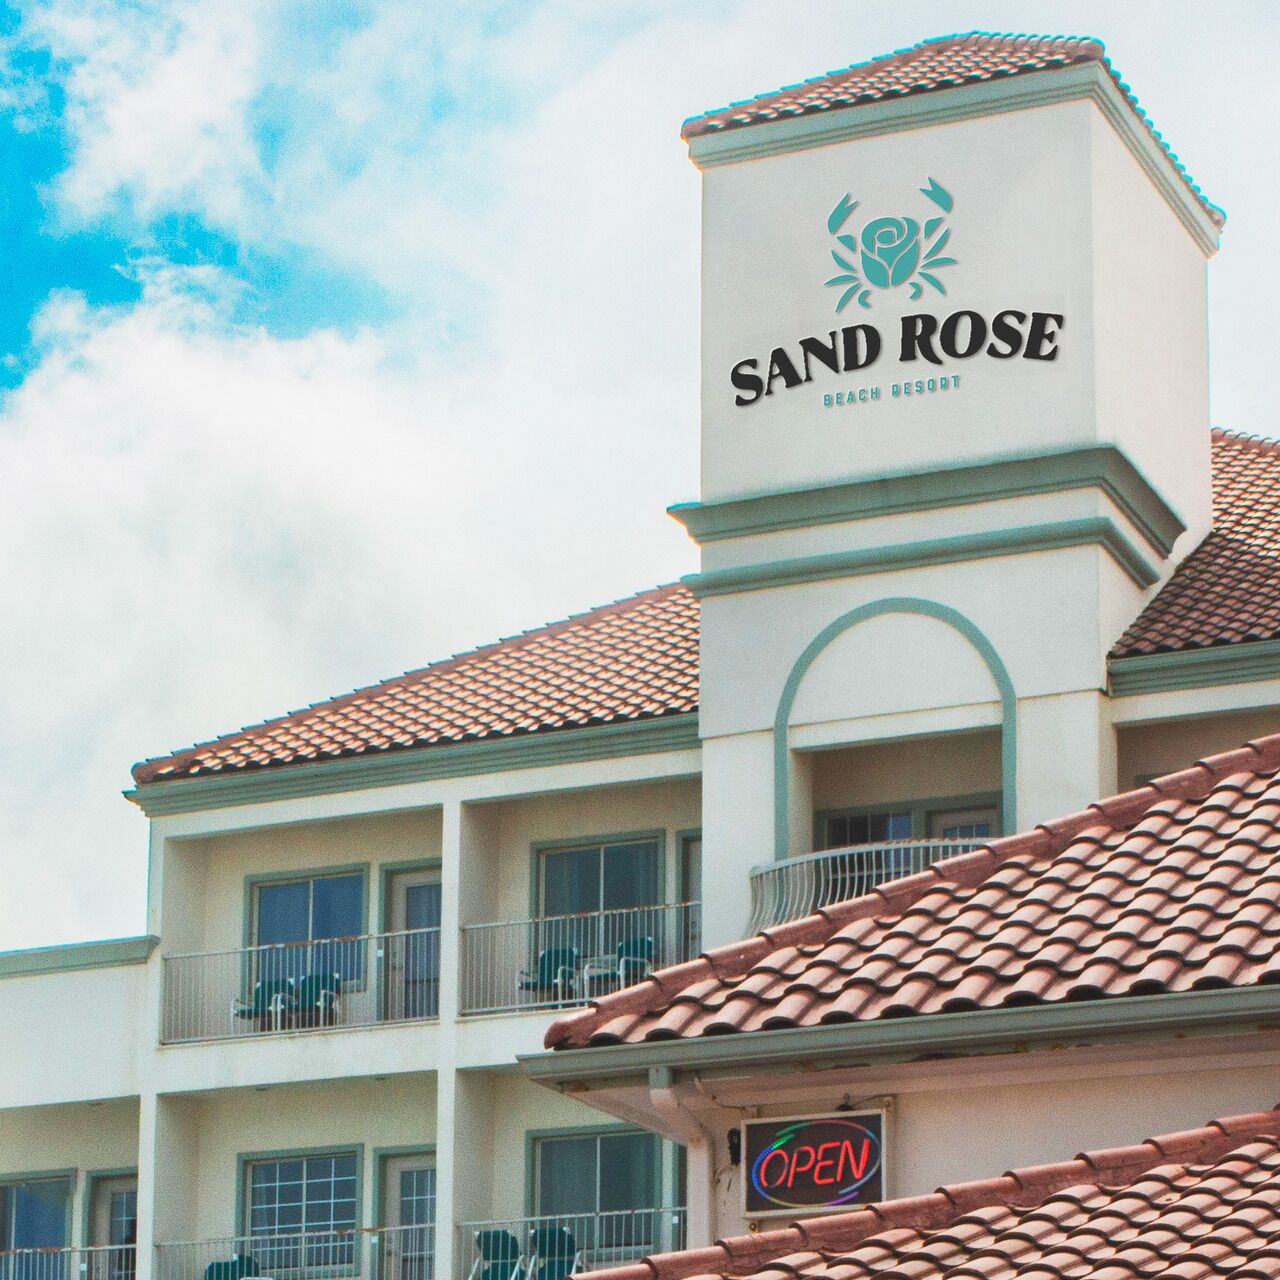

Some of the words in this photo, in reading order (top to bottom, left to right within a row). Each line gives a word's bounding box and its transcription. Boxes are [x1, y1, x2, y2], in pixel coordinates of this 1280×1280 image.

[729, 324, 882, 407] SAND
[898, 310, 1065, 366] ROSE
[823, 386, 880, 407] BEACH
[891, 375, 960, 397] RESORT
[759, 1138, 871, 1189] OPEN
